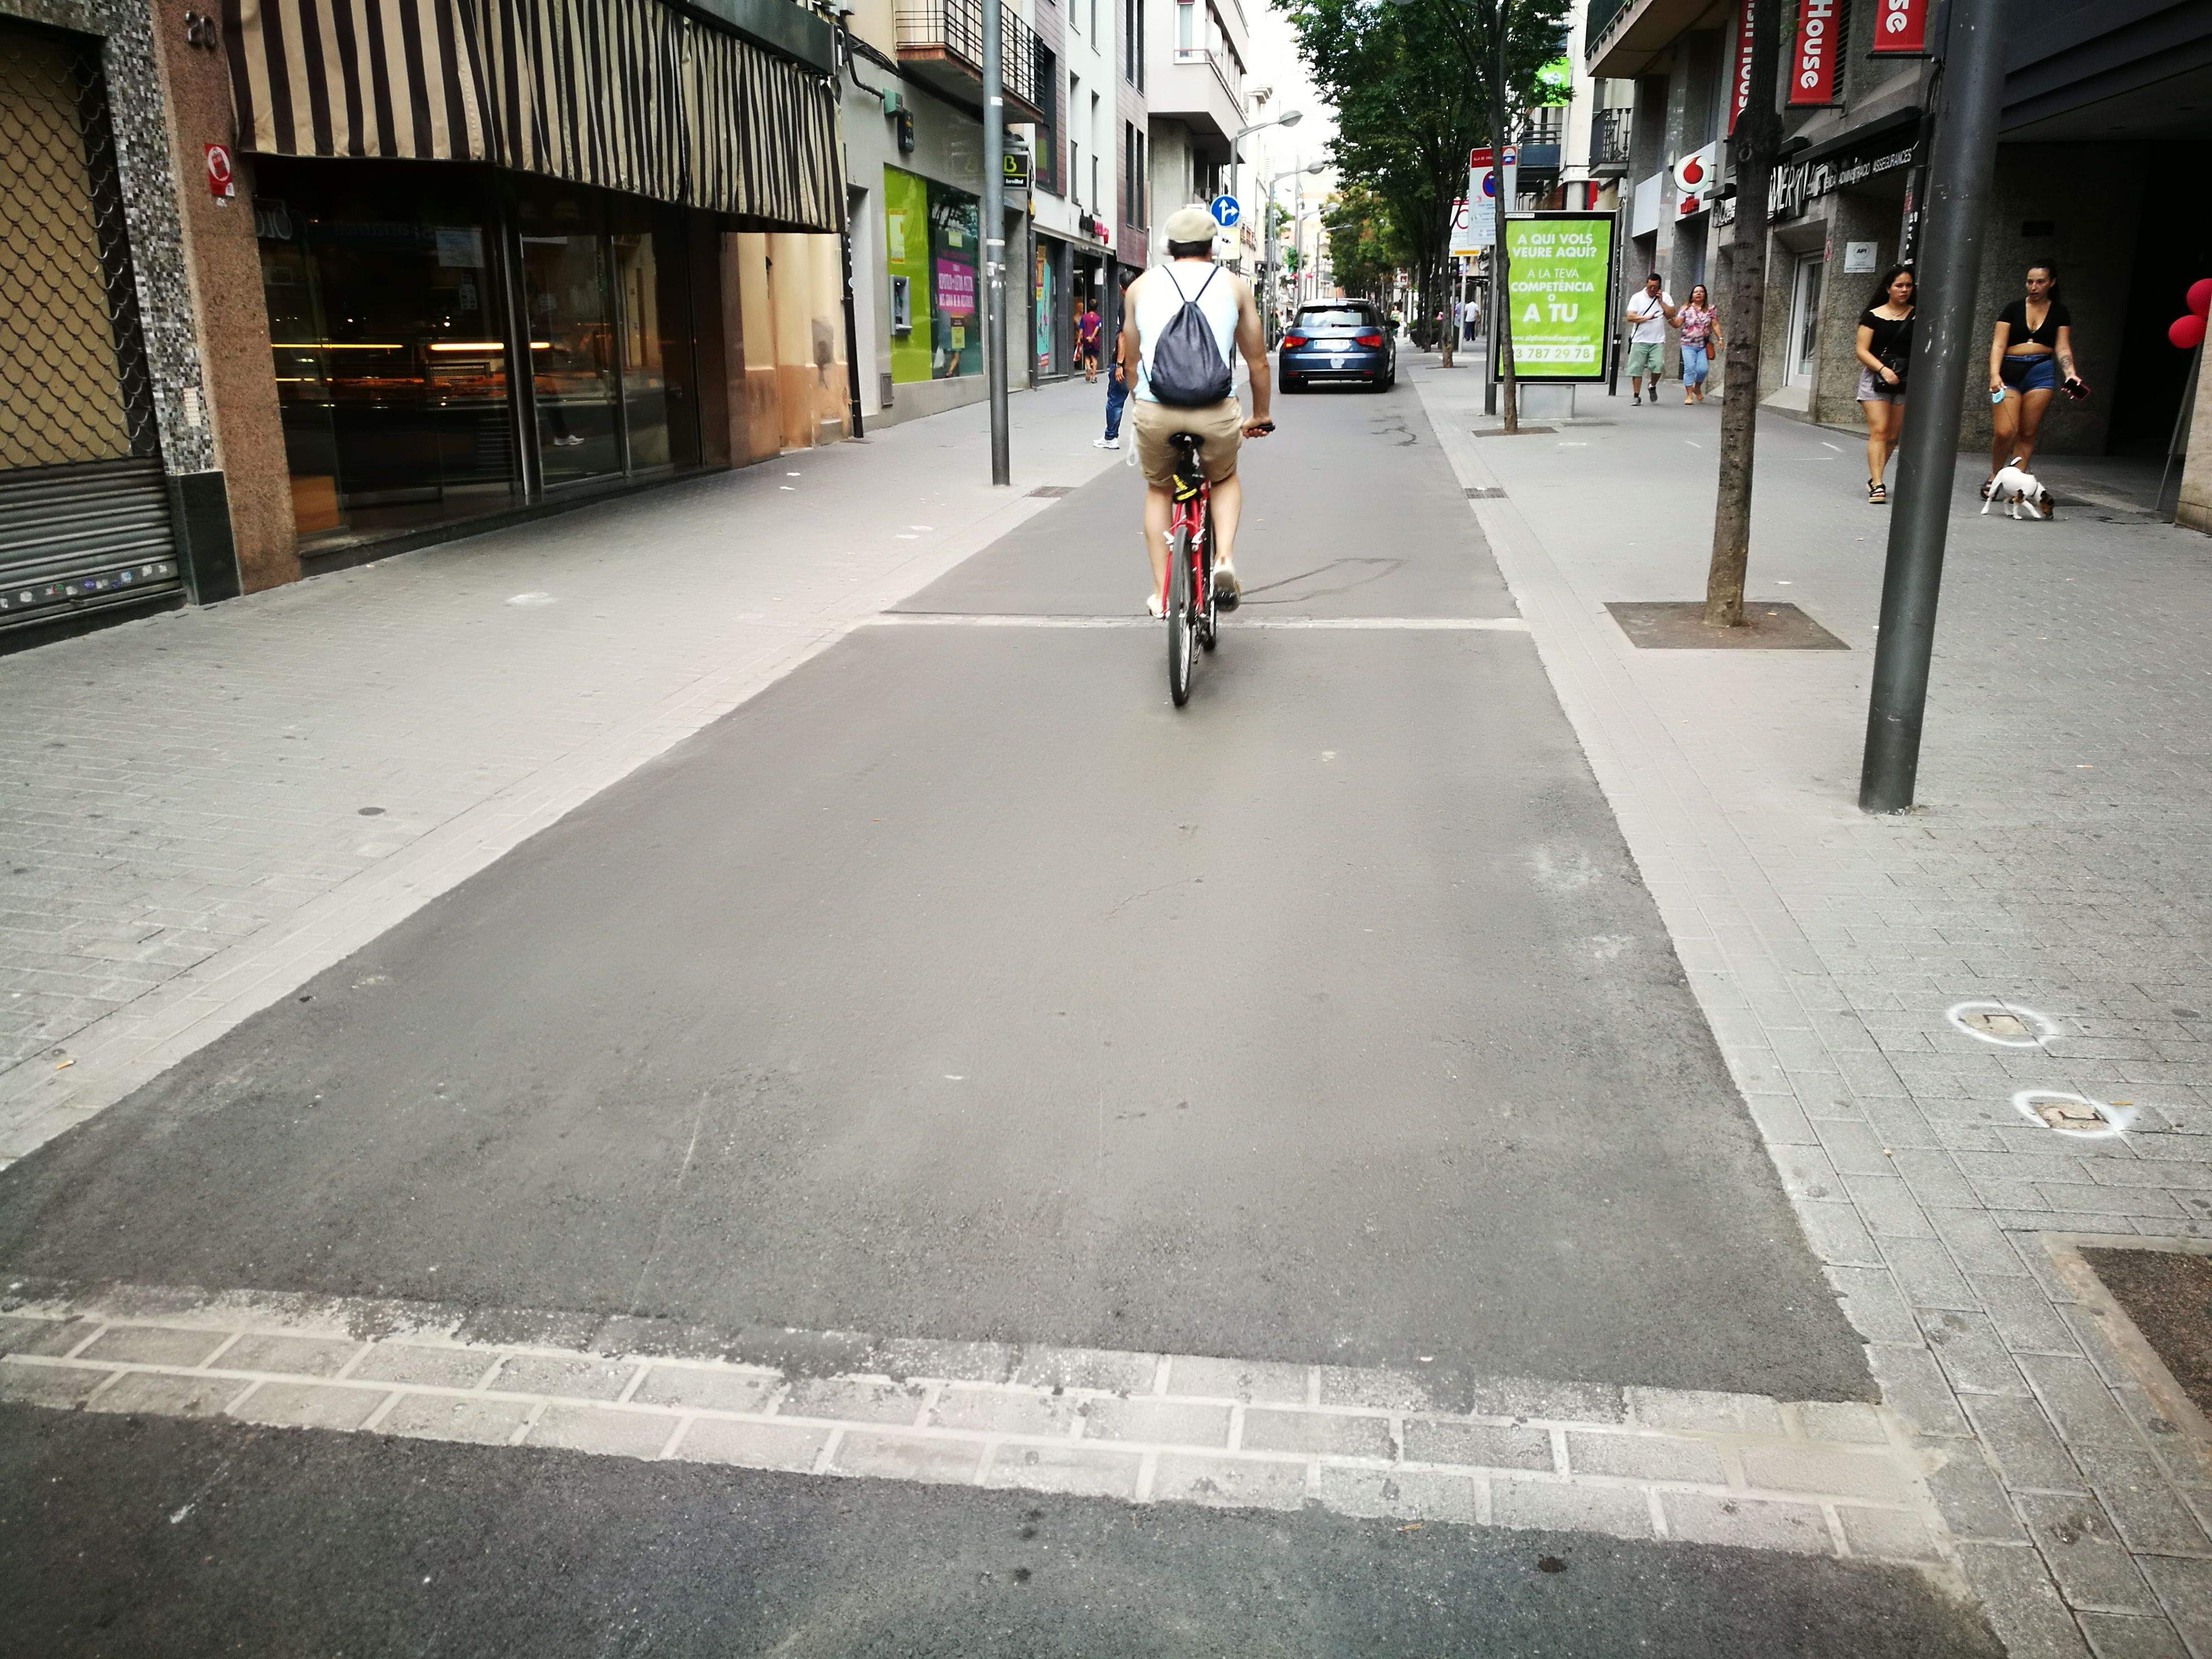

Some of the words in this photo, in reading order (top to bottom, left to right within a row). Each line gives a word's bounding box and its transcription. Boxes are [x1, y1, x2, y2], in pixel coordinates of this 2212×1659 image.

[185, 10, 216, 49] 20
[1800, 0, 1833, 89] House
[1517, 234, 1527, 244] A
[1531, 234, 1555, 244] QUI
[1559, 234, 1593, 244] VOLS
[1512, 247, 1552, 258] VEURE
[1527, 269, 1535, 278] A
[1539, 269, 1550, 278] LA
[1554, 268, 1579, 278] TEVA
[1511, 279, 1594, 292] COMPETÈNCIA
[1522, 303, 1541, 323] A
[1548, 303, 1579, 323] TU
[1513, 348, 1523, 358] 3
[1528, 348, 1550, 358] 787
[1555, 348, 1571, 358] 29
[1575, 348, 1590, 358] 78
